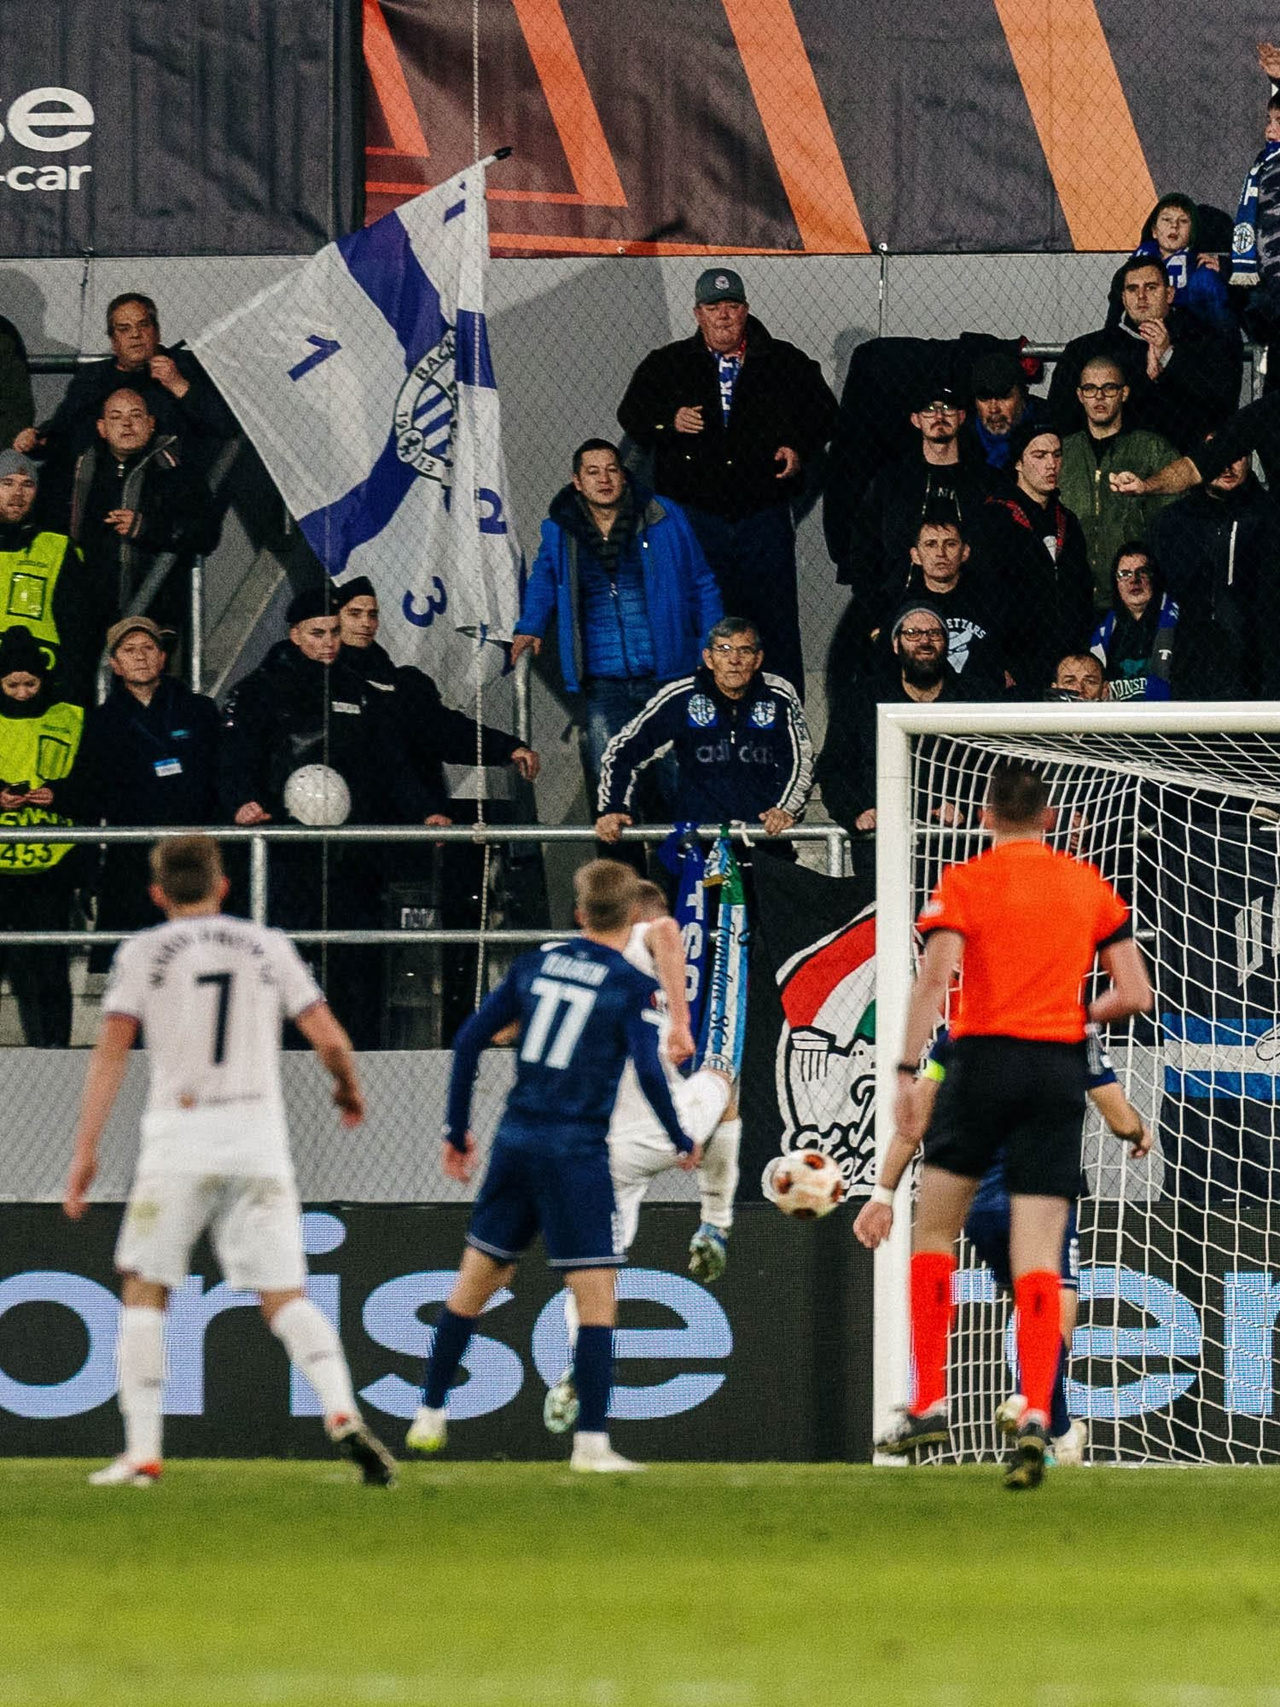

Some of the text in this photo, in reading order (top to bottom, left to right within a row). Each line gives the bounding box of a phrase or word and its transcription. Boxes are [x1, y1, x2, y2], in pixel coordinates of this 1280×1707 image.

[0, 86, 95, 152] e
[196, 969, 235, 1067] 7
[520, 976, 599, 1071] 17
